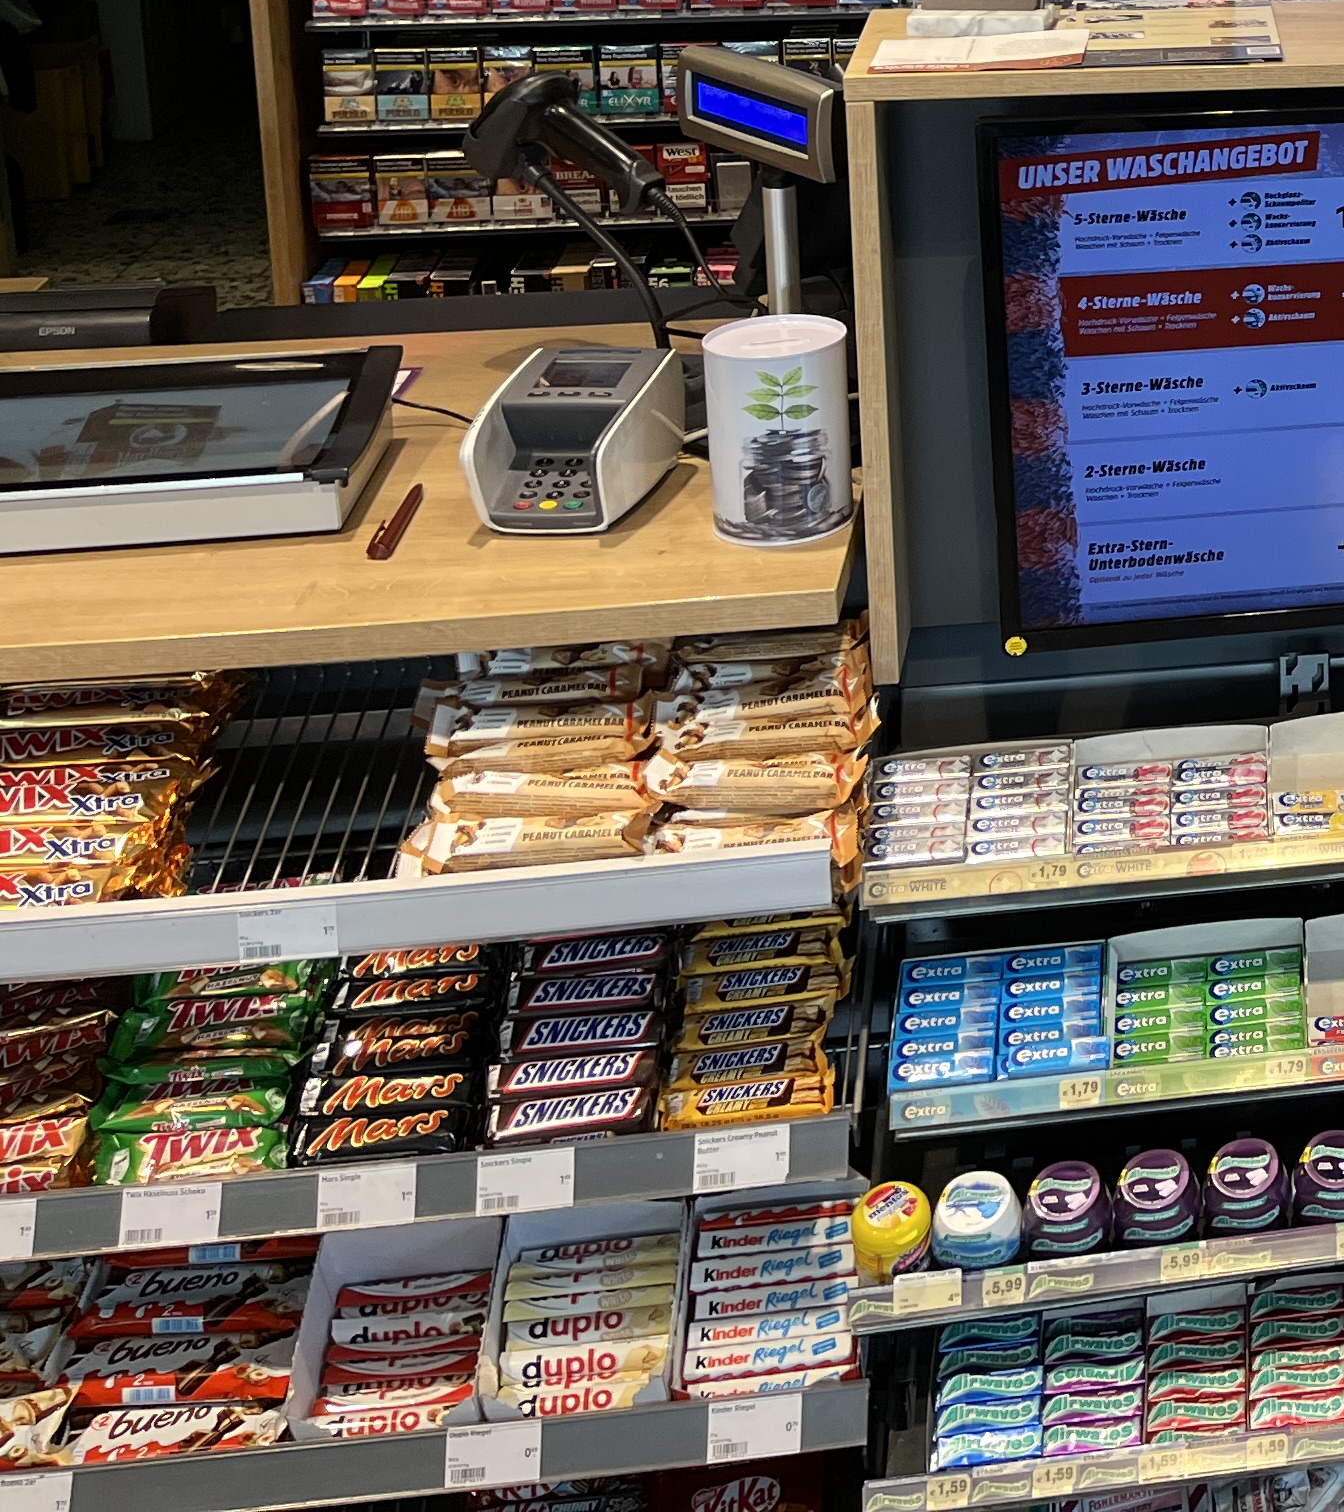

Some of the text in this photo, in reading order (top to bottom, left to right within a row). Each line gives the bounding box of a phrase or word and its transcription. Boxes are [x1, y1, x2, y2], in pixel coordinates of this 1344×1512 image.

[1017, 140, 1309, 189] UNSER WASCHANGEBOT
[1074, 207, 1187, 226] 5-Sterne-Wäsche
[1077, 290, 1202, 310] 4-Sterne-Wäsche
[38, 325, 75, 336] EPSON
[1088, 539, 1174, 556] Extra-Stern-
[1088, 548, 1224, 572] Unterbodenwäsche
[46, 833, 116, 858] Xtra
[522, 825, 613, 842] PEANUT CARAMEL
[509, 1089, 643, 1136] SNICKERS
[307, 1109, 448, 1156] Mars
[695, 1336, 806, 1370] kinder Riegel
[521, 1349, 616, 1388] duplo
[108, 1400, 213, 1442] bueno
